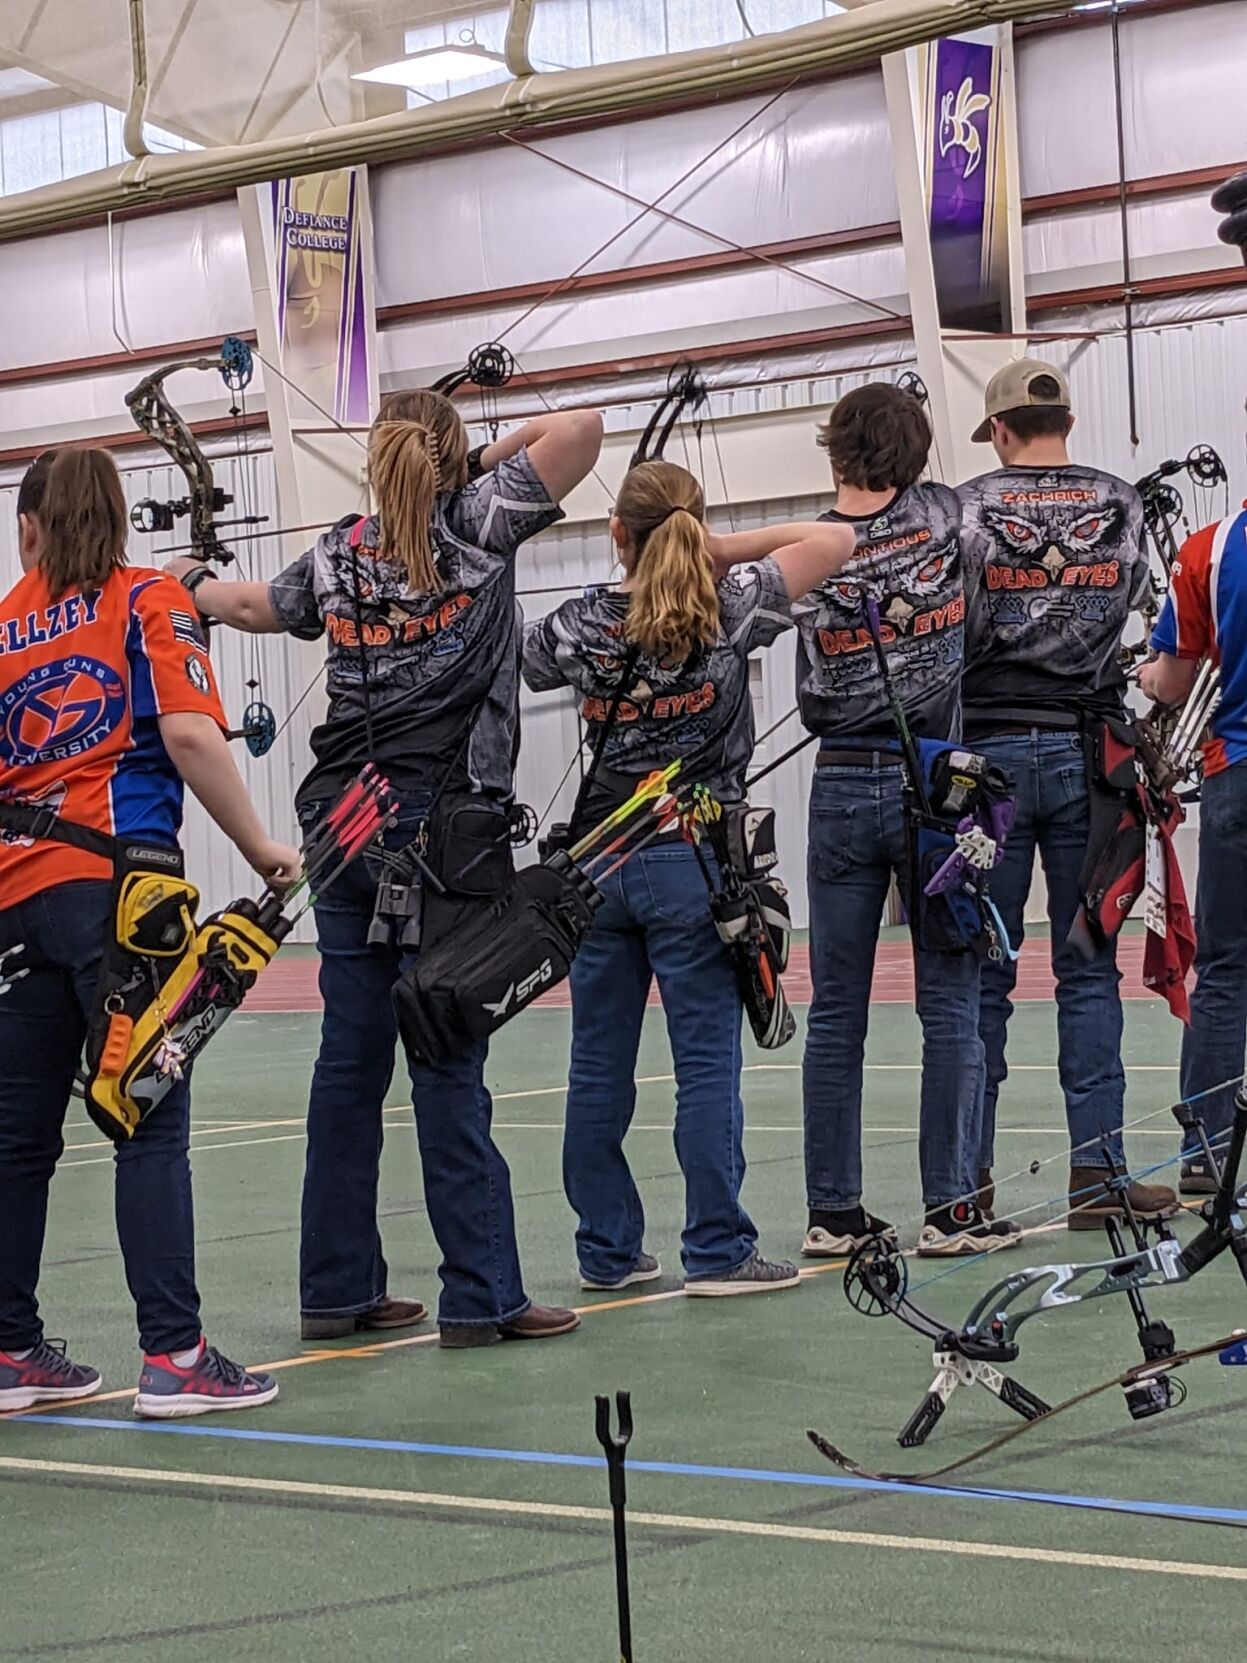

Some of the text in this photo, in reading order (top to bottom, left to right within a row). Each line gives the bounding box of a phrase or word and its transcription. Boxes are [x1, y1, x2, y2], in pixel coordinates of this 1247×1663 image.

[284, 206, 349, 230] DEFIANCE
[286, 227, 347, 250] COLLEGE
[1001, 490, 1096, 504] ZACHRICH
[986, 560, 1119, 590] DEAD EYES
[817, 627, 896, 656] DEAD
[653, 681, 715, 718] EYES
[154, 1002, 218, 1085] LEND
